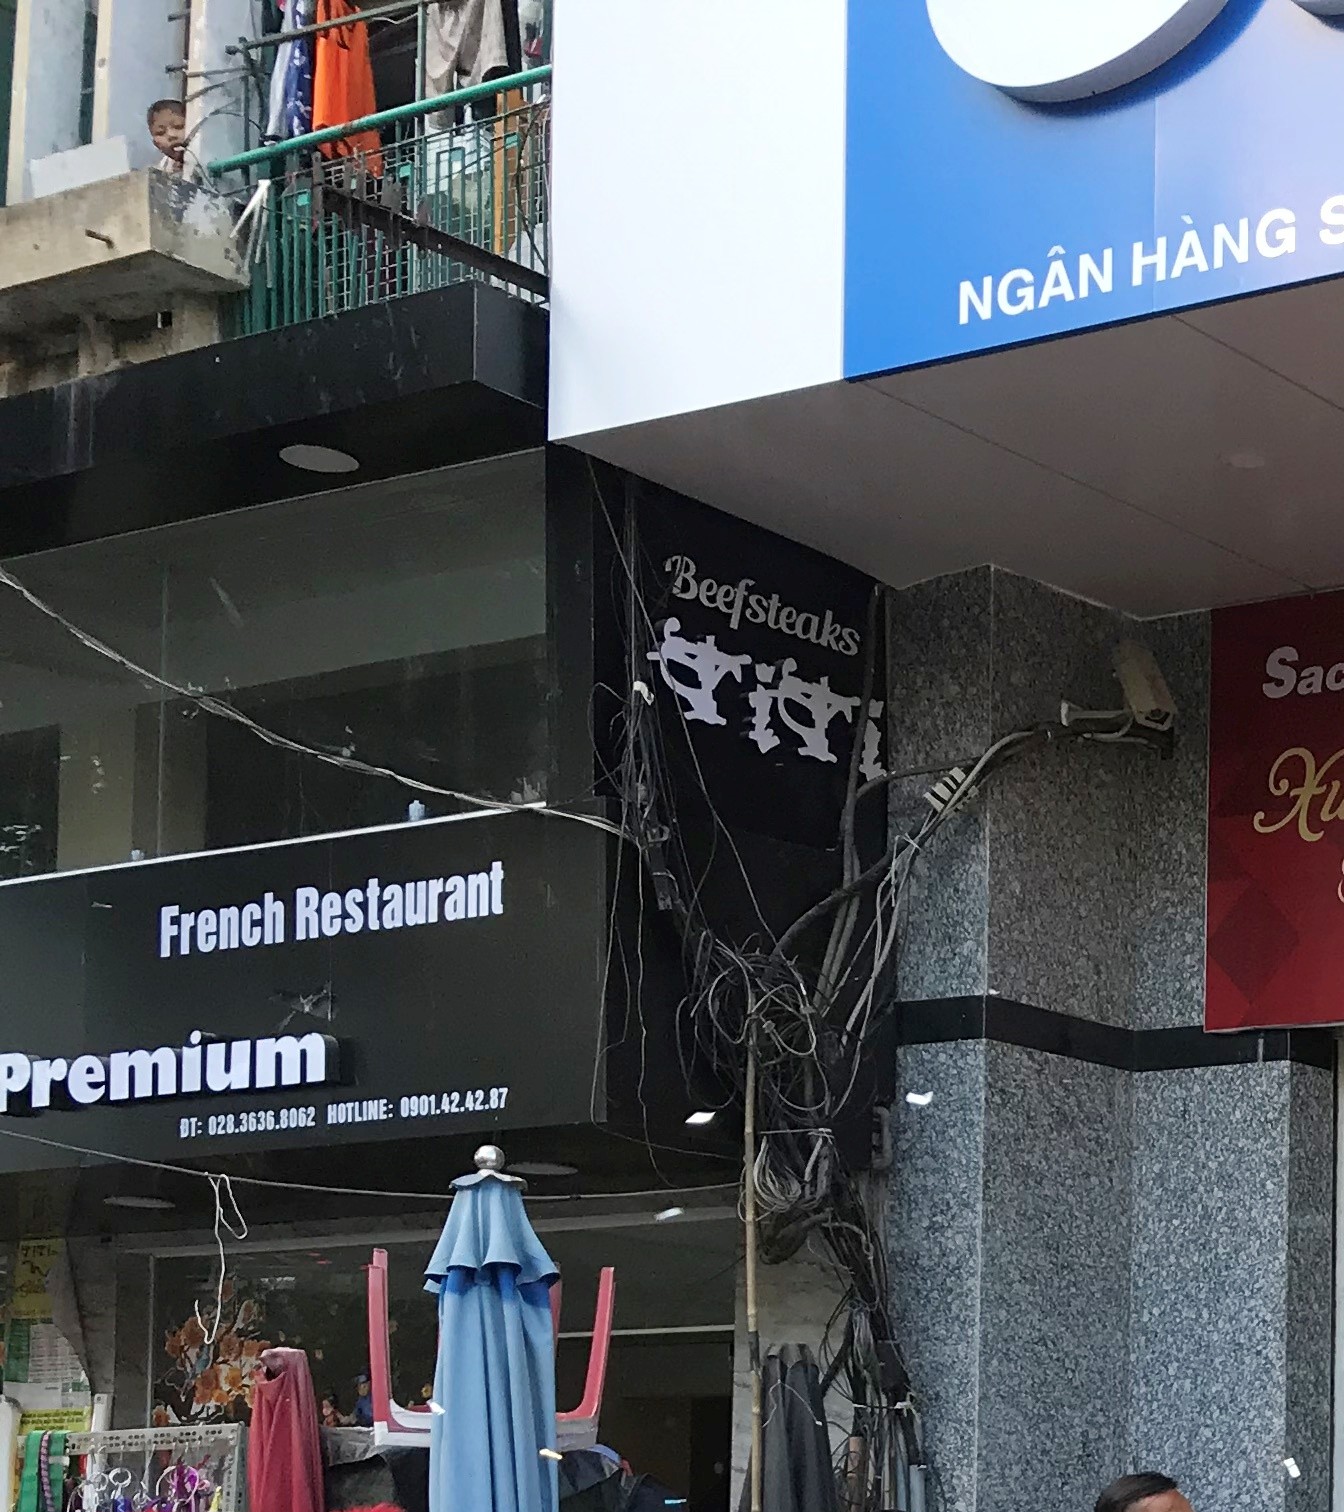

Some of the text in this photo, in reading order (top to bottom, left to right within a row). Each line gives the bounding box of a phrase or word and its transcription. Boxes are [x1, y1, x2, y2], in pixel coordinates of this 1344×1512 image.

[958, 245, 1112, 324] NGÂN
[1131, 215, 1296, 286] HÀNG
[665, 555, 860, 656] Beefsteaks
[160, 860, 504, 958] French Restaurant
[0, 1030, 325, 1112] Premium
[208, 1106, 316, 1136] 028.3636.8062
[327, 1099, 394, 1125] HOTLINE:
[400, 1087, 509, 1118] 0901.42.42.87
